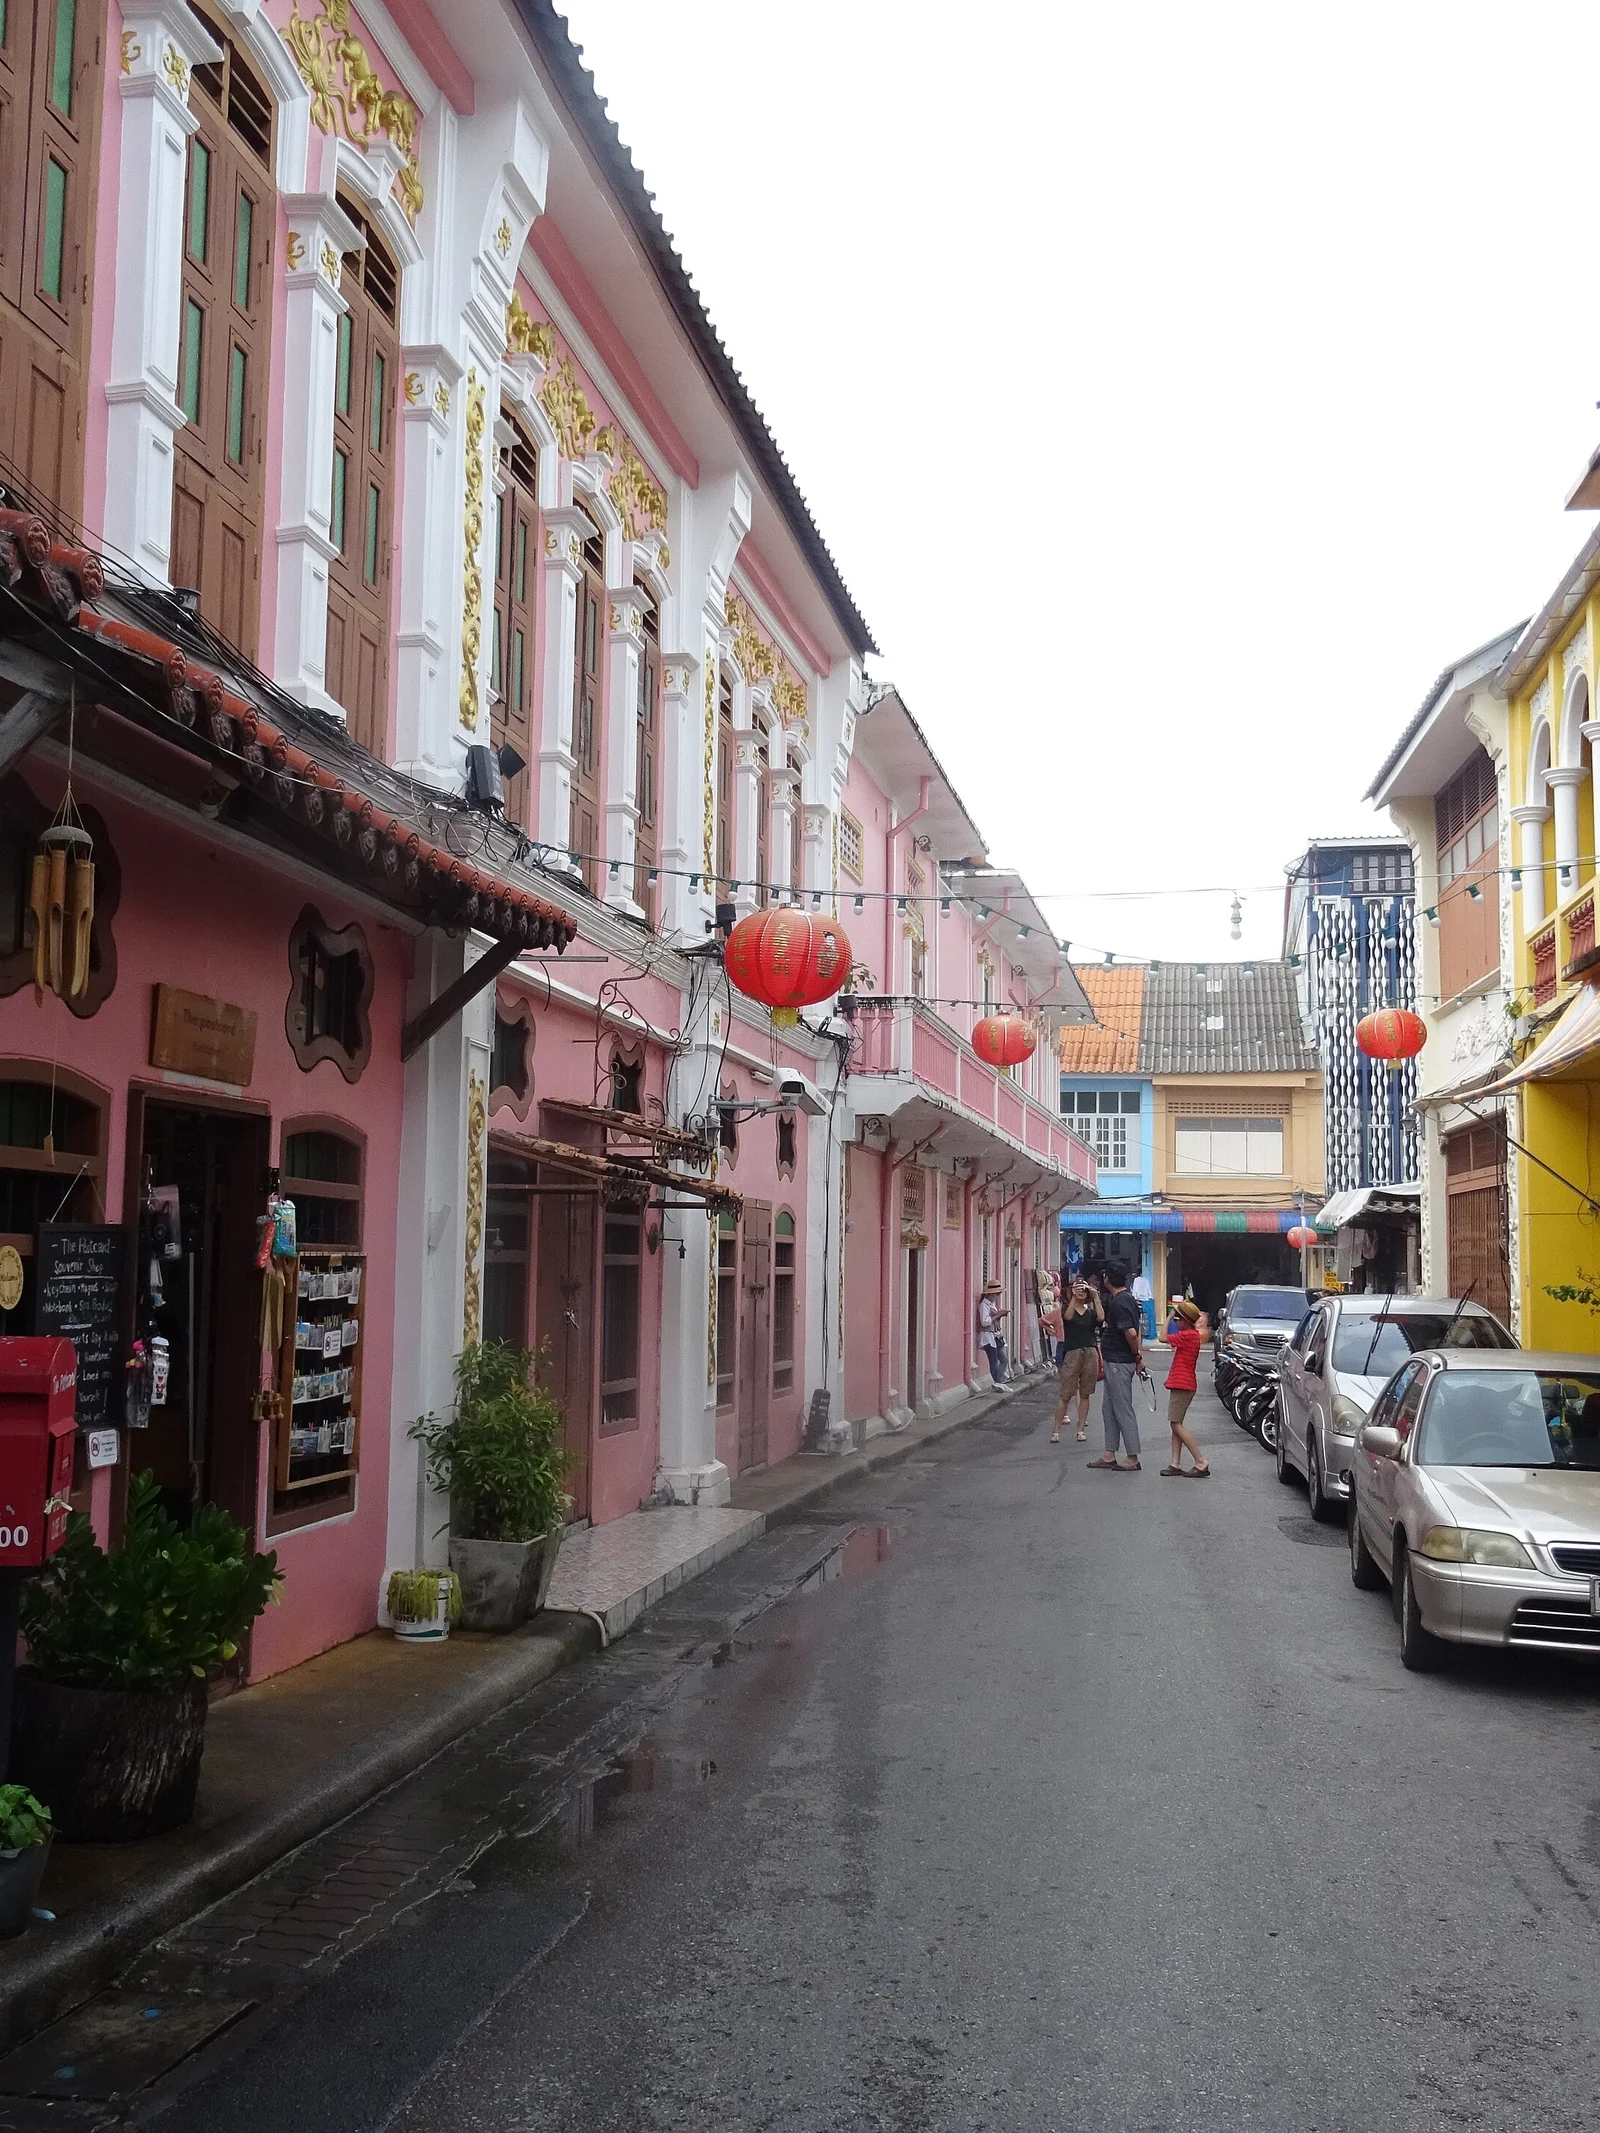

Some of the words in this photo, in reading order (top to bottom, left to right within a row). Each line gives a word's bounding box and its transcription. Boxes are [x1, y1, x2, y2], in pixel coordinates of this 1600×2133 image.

[61, 1238, 76, 1255] The
[54, 1258, 84, 1275] Souvenir
[87, 1258, 104, 1275] Shop
